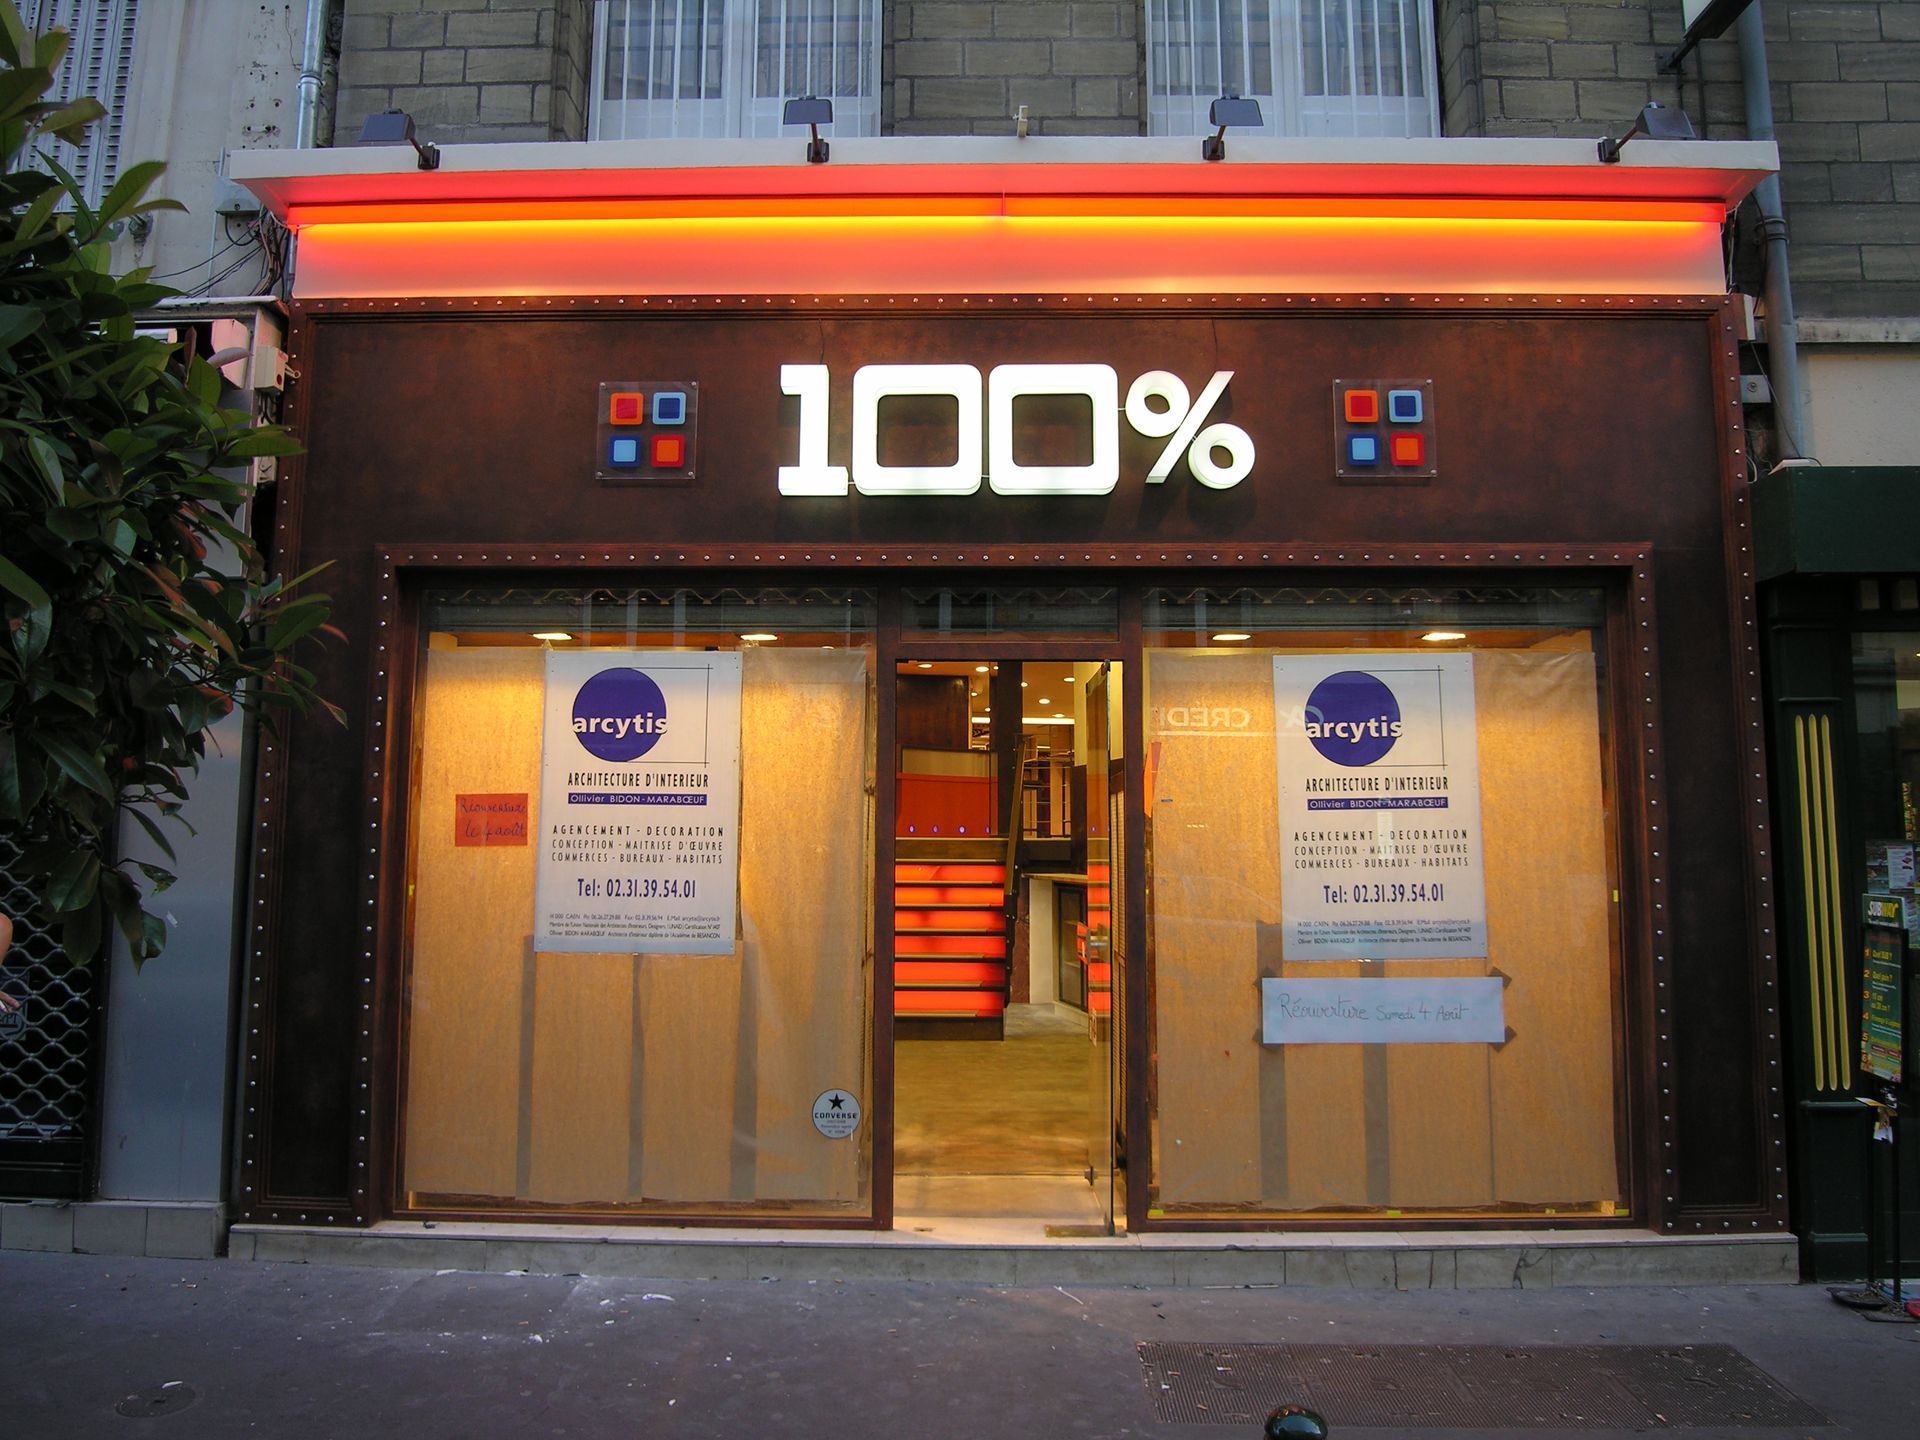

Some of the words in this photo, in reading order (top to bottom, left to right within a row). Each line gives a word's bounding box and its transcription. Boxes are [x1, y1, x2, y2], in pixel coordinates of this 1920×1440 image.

[778, 363, 1256, 496] 100%
[572, 712, 668, 739] arcytis
[1305, 715, 1404, 745] arcytis
[567, 772, 640, 787] ARCHITECTURE
[645, 772, 709, 788] D'INTERIEUR
[1305, 777, 1380, 792] ARCHITECTURE
[1385, 777, 1449, 791] D'INTERIEUR
[553, 825, 631, 836] AGENCEMENT
[647, 825, 724, 837] DECORATION
[1294, 830, 1374, 841] AGENCEMENT
[1390, 829, 1468, 840] DECORATION
[552, 840, 614, 849] CONCEPTION
[625, 840, 672, 850] MAITRISE
[1294, 845, 1358, 856] CONCEPTION
[1369, 845, 1416, 855] MAITRISE
[551, 852, 608, 863] COMMERCES
[619, 853, 665, 864] BUREAUX
[676, 854, 723, 864] HABITATS
[1295, 858, 1353, 869] COMMERCES
[1364, 858, 1410, 868] BUREAUX
[1421, 857, 1469, 867] HABITATS
[577, 878, 601, 897] Tel:
[606, 879, 696, 898] 02.31.39.54.01
[1324, 885, 1348, 904] Tel:
[1353, 883, 1444, 903] 02.31.39.54.01
[1417, 1000, 1432, 1021] 4
